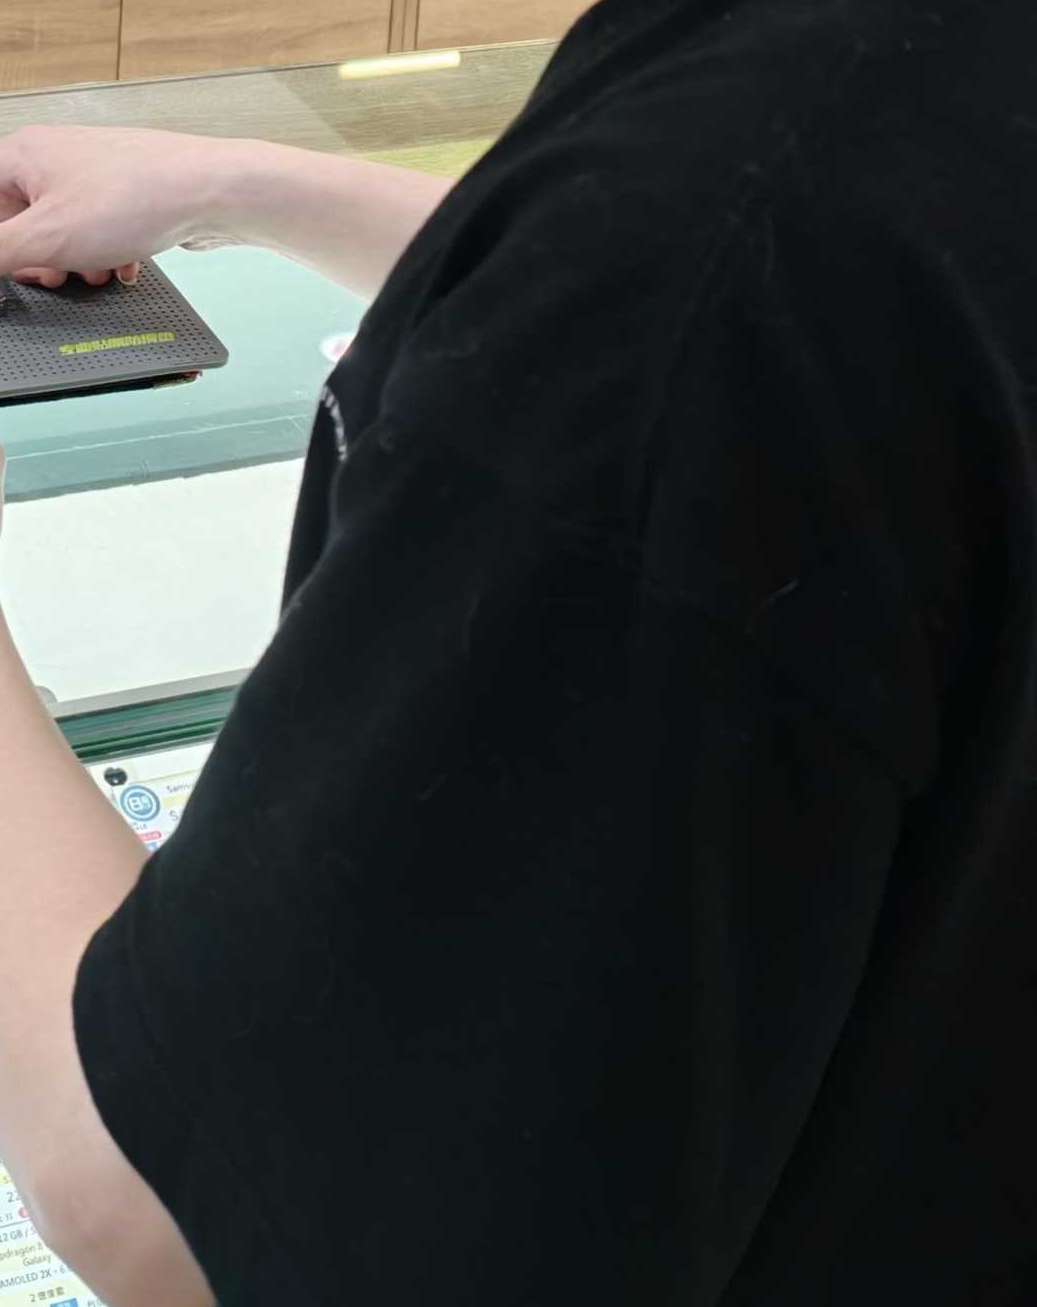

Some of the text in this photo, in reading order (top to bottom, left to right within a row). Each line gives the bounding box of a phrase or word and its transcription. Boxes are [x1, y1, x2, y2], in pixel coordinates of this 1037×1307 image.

[10, 1229, 24, 1240] GB
[22, 1254, 52, 1267] Galaxy
[0, 1269, 53, 1289] AMOLED 2X
